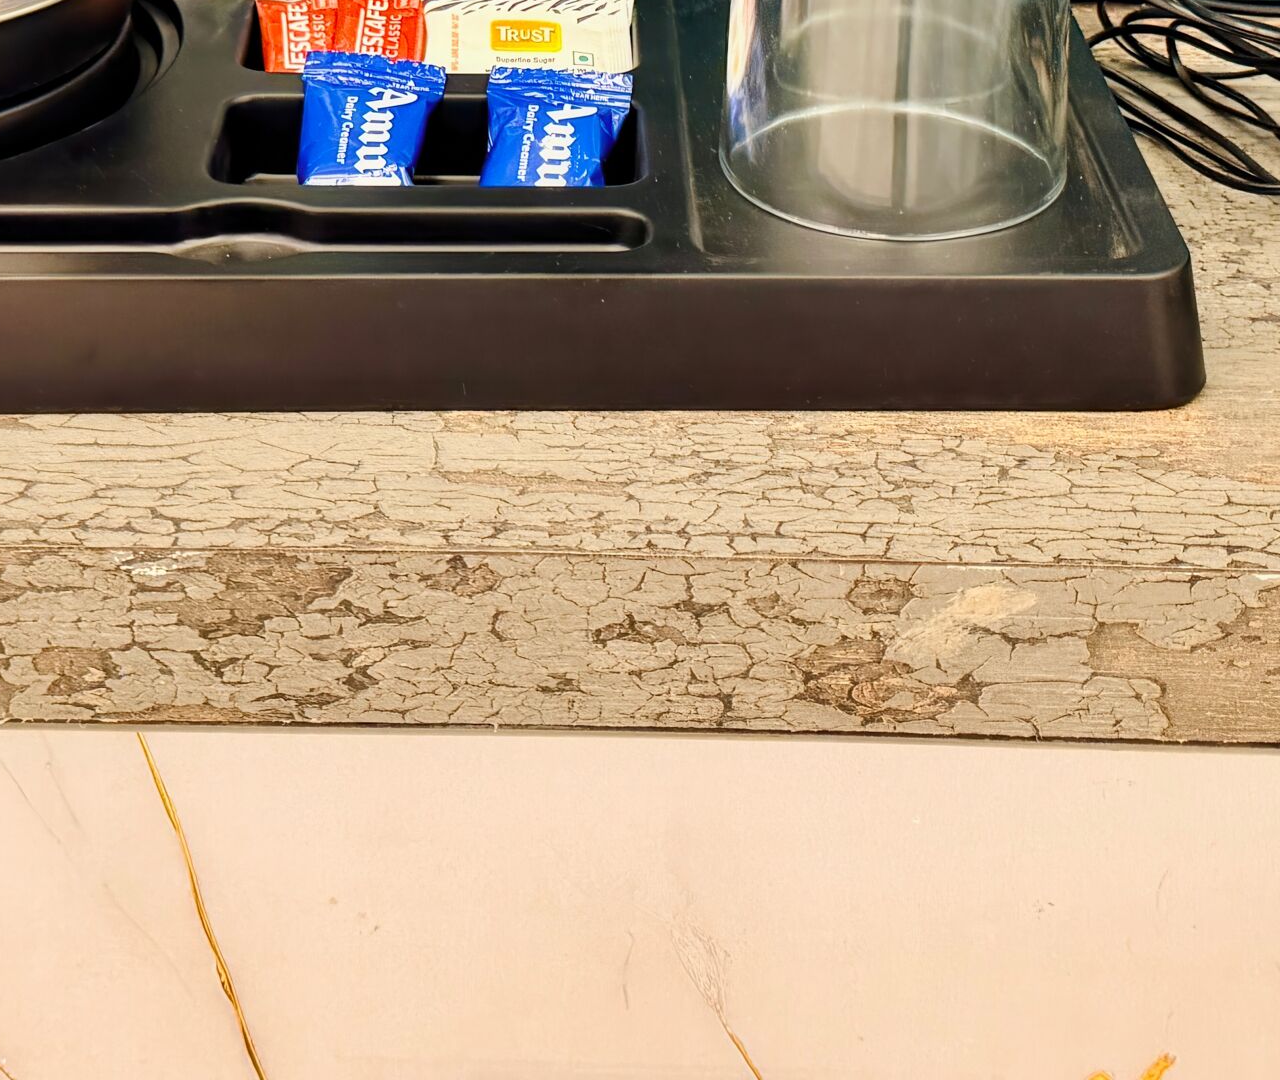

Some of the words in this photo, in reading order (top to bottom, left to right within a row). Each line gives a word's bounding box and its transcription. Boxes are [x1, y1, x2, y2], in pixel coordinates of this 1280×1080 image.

[385, 14, 403, 58] CLASSIC
[496, 26, 554, 43] TRUST
[533, 56, 556, 64] Sugar
[341, 96, 359, 123] Dairy
[523, 104, 539, 134] Dairy
[336, 122, 353, 165] Creamer
[517, 132, 535, 182] Creamer
[535, 103, 598, 186] Amu
